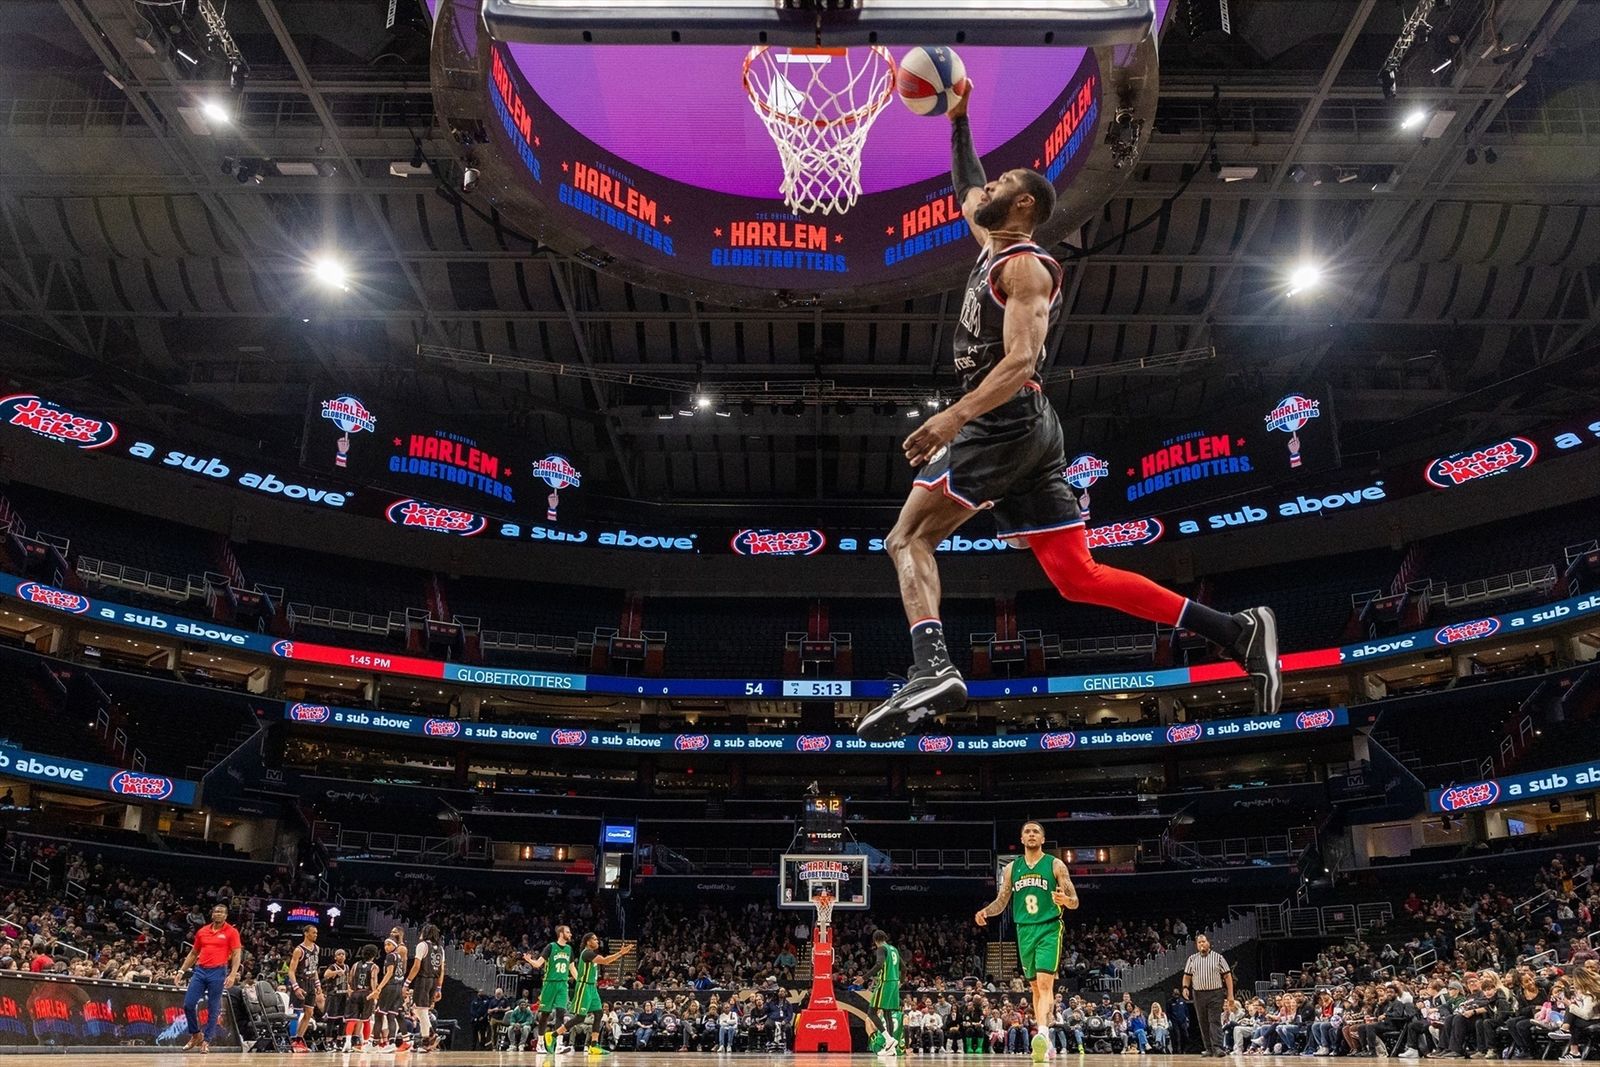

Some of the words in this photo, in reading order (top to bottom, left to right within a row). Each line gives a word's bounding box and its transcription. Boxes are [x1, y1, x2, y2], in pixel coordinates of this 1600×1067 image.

[493, 48, 532, 145] HARLEM
[1045, 77, 1092, 167] HARLEM
[574, 161, 657, 227] HARLEM
[559, 183, 674, 256] GLOBETROTTERS
[903, 194, 961, 239] HARL
[730, 221, 827, 250] HARLEM
[885, 219, 969, 266] GLOBETROT
[711, 247, 847, 273] GLOBETROTTERS
[13, 400, 102, 434] Jersey
[330, 400, 370, 420] HARLEM
[1271, 400, 1312, 421] HARLEM
[322, 410, 374, 431] GLOBETROTTERS
[1267, 409, 1319, 431] GLOBETROTTERS
[435, 430, 446, 438] THE
[449, 433, 477, 447] ORIGINAL
[1162, 439, 1173, 447] THE
[1176, 431, 1205, 443] ORIGINAL
[1554, 432, 1582, 449] a
[129, 441, 154, 458] a
[163, 450, 230, 478] sub
[409, 434, 498, 478] HARLEM
[1141, 434, 1231, 479] HARLEM
[1438, 441, 1517, 475] Jersey
[539, 460, 575, 477] HARLEM
[1066, 460, 1102, 477] HARLEM
[389, 455, 514, 502] GLOBETROTTERS
[1126, 455, 1251, 501] GLOBETROTTERS
[401, 502, 474, 523] Jersey
[1179, 520, 1199, 534] a
[1209, 506, 1268, 529] sub
[501, 523, 520, 537] a
[743, 531, 812, 544] Jersey
[839, 538, 857, 550] a
[936, 536, 1007, 550] abov
[27, 585, 80, 604] Jersey
[101, 607, 115, 619] a
[124, 610, 167, 628] sub
[1511, 617, 1524, 627] a
[1532, 605, 1570, 622] sub
[1444, 620, 1490, 636] Jersey
[350, 655, 370, 665] 1:45
[374, 657, 390, 668] PM
[458, 668, 572, 689] GLOBETROTTERS
[1083, 675, 1154, 691] GENERALS
[745, 683, 763, 695] 54
[812, 683, 843, 695] 5:13
[335, 713, 342, 721] a
[346, 714, 370, 725] sub
[476, 728, 498, 738] sub
[1091, 733, 1113, 744] sub
[1207, 728, 1215, 736] a
[1218, 723, 1240, 735] sub
[602, 735, 623, 745] sub
[725, 738, 745, 748] sub
[836, 740, 843, 748] a
[846, 738, 867, 748] sub
[957, 741, 965, 749] a
[968, 739, 989, 749] sub
[119, 774, 165, 787] Jersey
[1509, 784, 1522, 795] a
[1529, 774, 1568, 792] sub
[1448, 783, 1490, 801] Jersey
[800, 871, 849, 880] GLOBETROTTERS
[807, 861, 842, 872] HARLEM
[1015, 878, 1048, 891] GENERALS
[1025, 894, 1038, 914] 8
[555, 962, 567, 973] 18
[34, 999, 71, 1020] HARLEM
